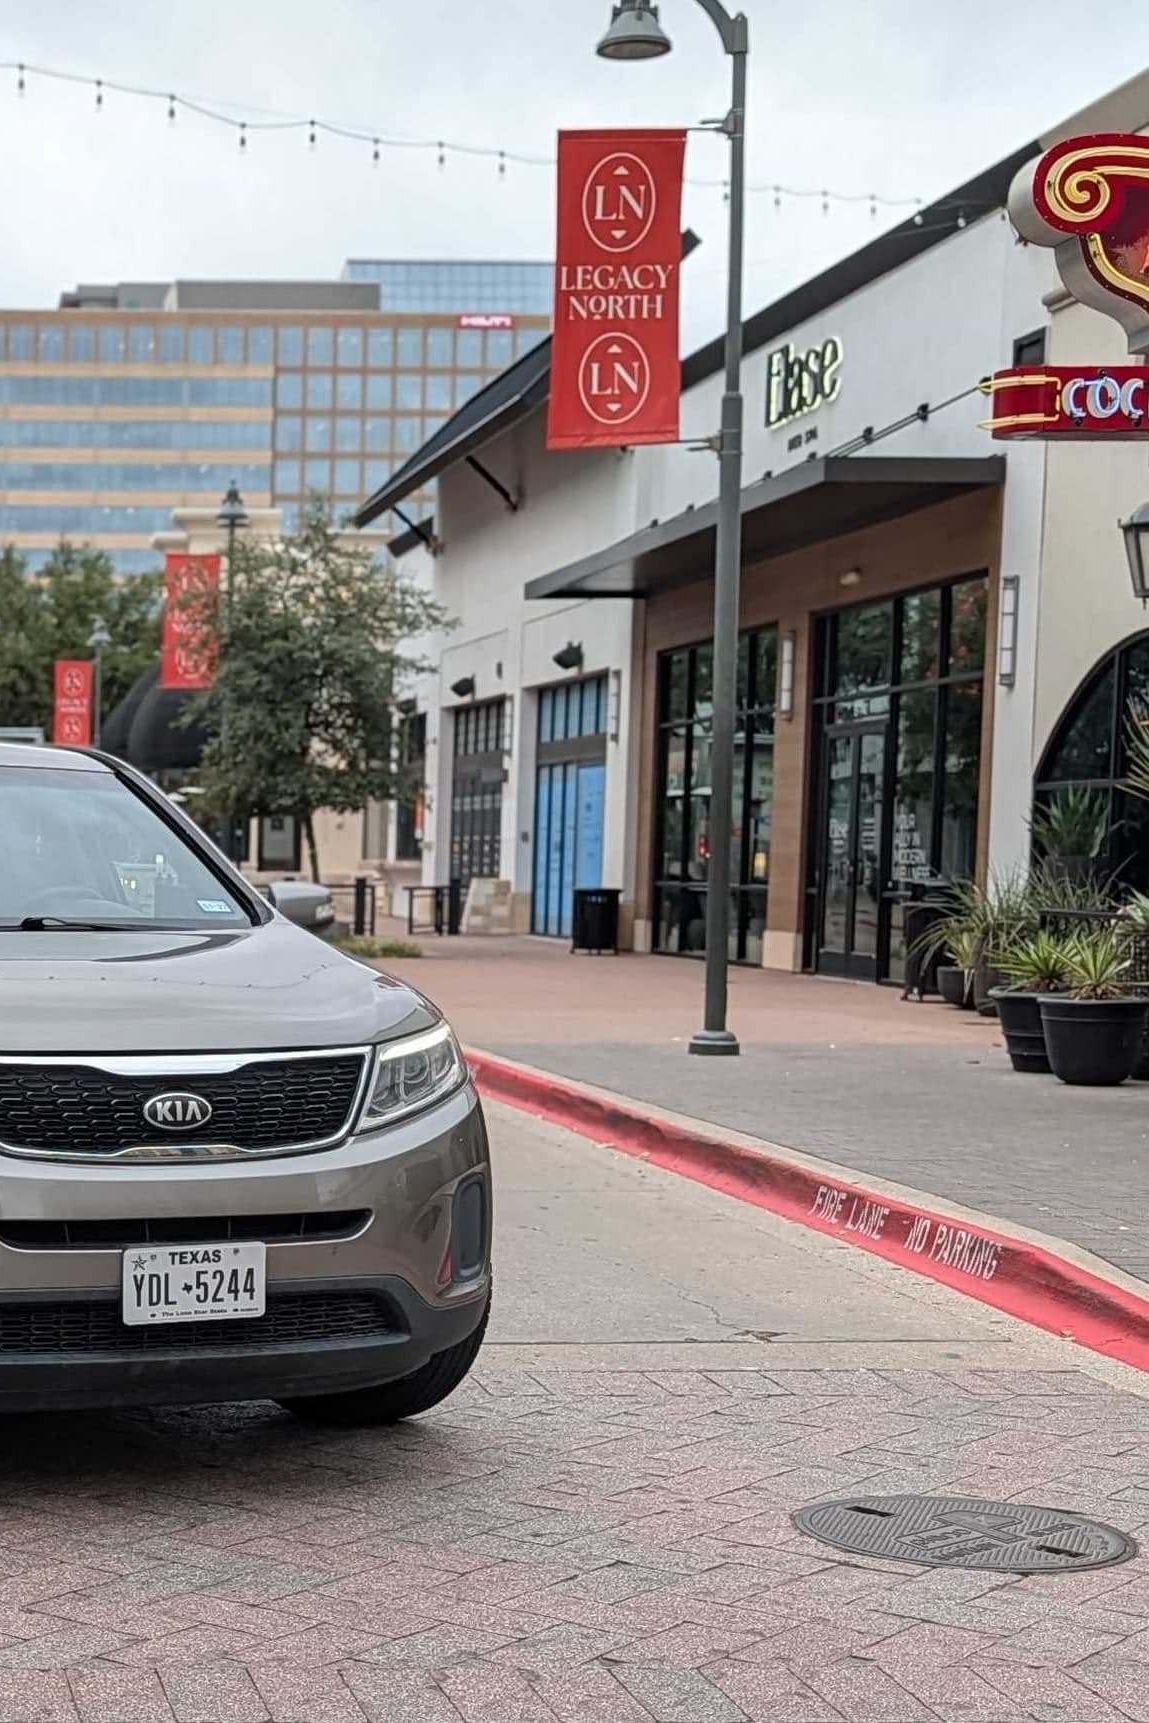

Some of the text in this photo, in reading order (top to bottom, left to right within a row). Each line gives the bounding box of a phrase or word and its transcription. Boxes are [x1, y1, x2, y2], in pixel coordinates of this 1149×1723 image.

[594, 185, 646, 220] LN
[560, 264, 673, 291] LEGACY
[569, 294, 663, 320] NORTH
[590, 361, 640, 395] LN
[1061, 376, 1149, 419] COC
[155, 1100, 202, 1121] KIA
[807, 1185, 1001, 1280] FIRE LANE NO PARKING
[168, 1249, 222, 1265] TEXAS
[132, 1267, 255, 1308] YDL 5244
